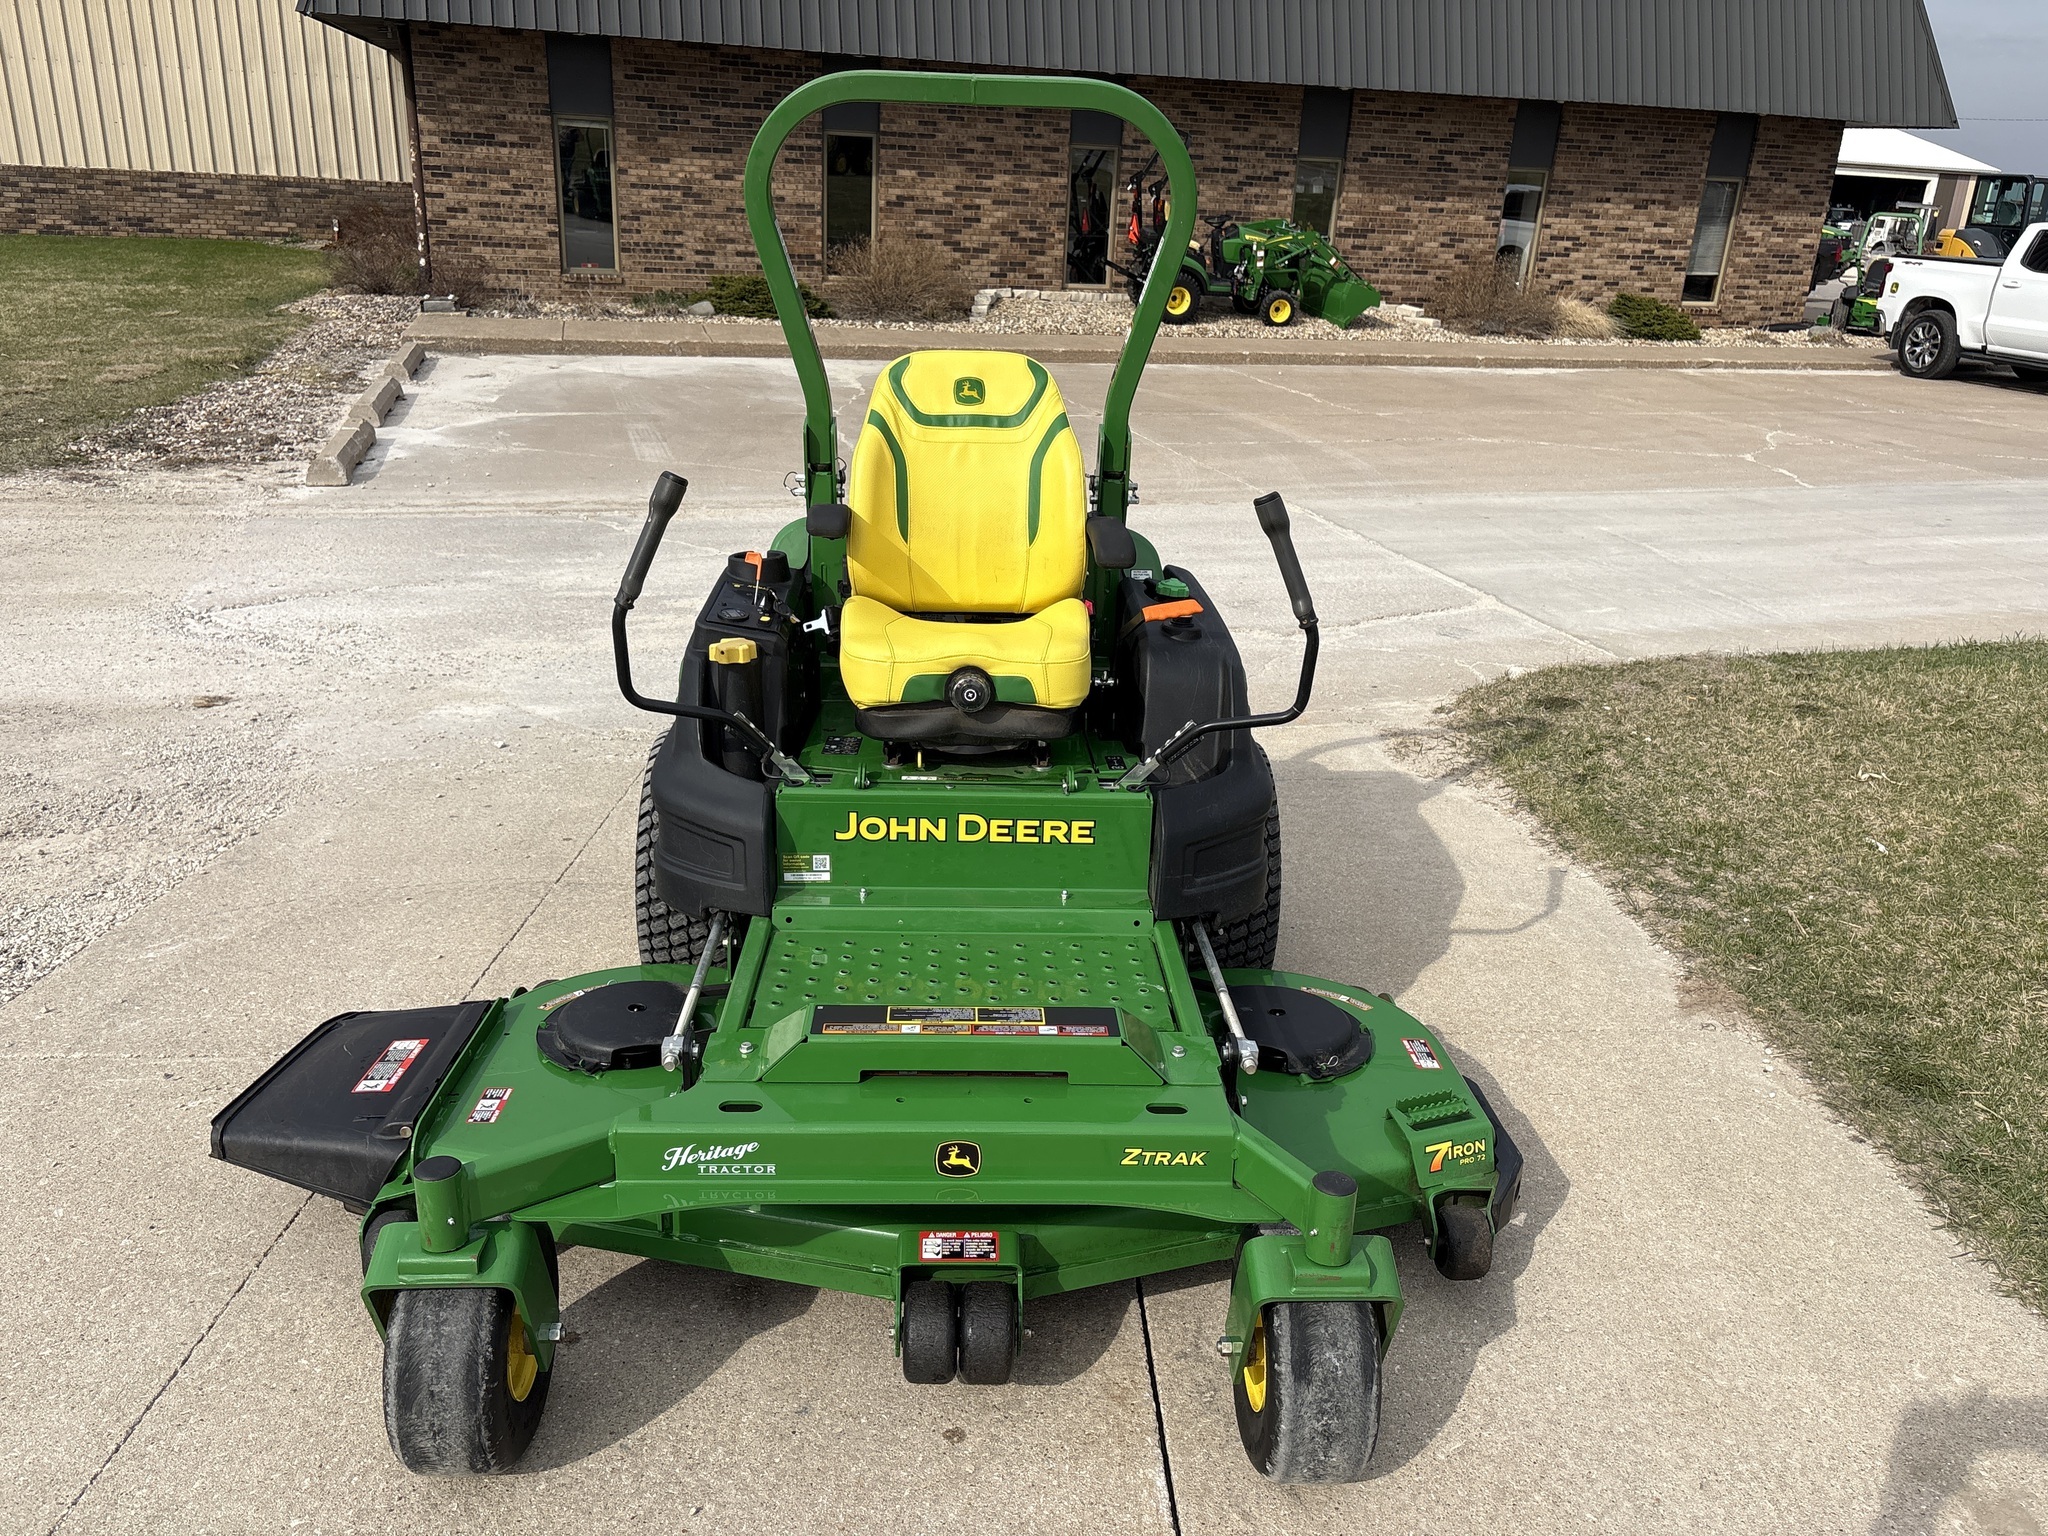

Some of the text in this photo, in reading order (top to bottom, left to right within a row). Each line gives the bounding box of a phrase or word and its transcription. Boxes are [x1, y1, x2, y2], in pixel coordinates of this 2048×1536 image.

[834, 811, 1096, 845] JOHN DEERE
[662, 1142, 760, 1171] Heritage
[1120, 1147, 1209, 1166] ZTRAK
[1459, 1154, 1486, 1166] PRO 72
[698, 1165, 776, 1174] TRACTOR
